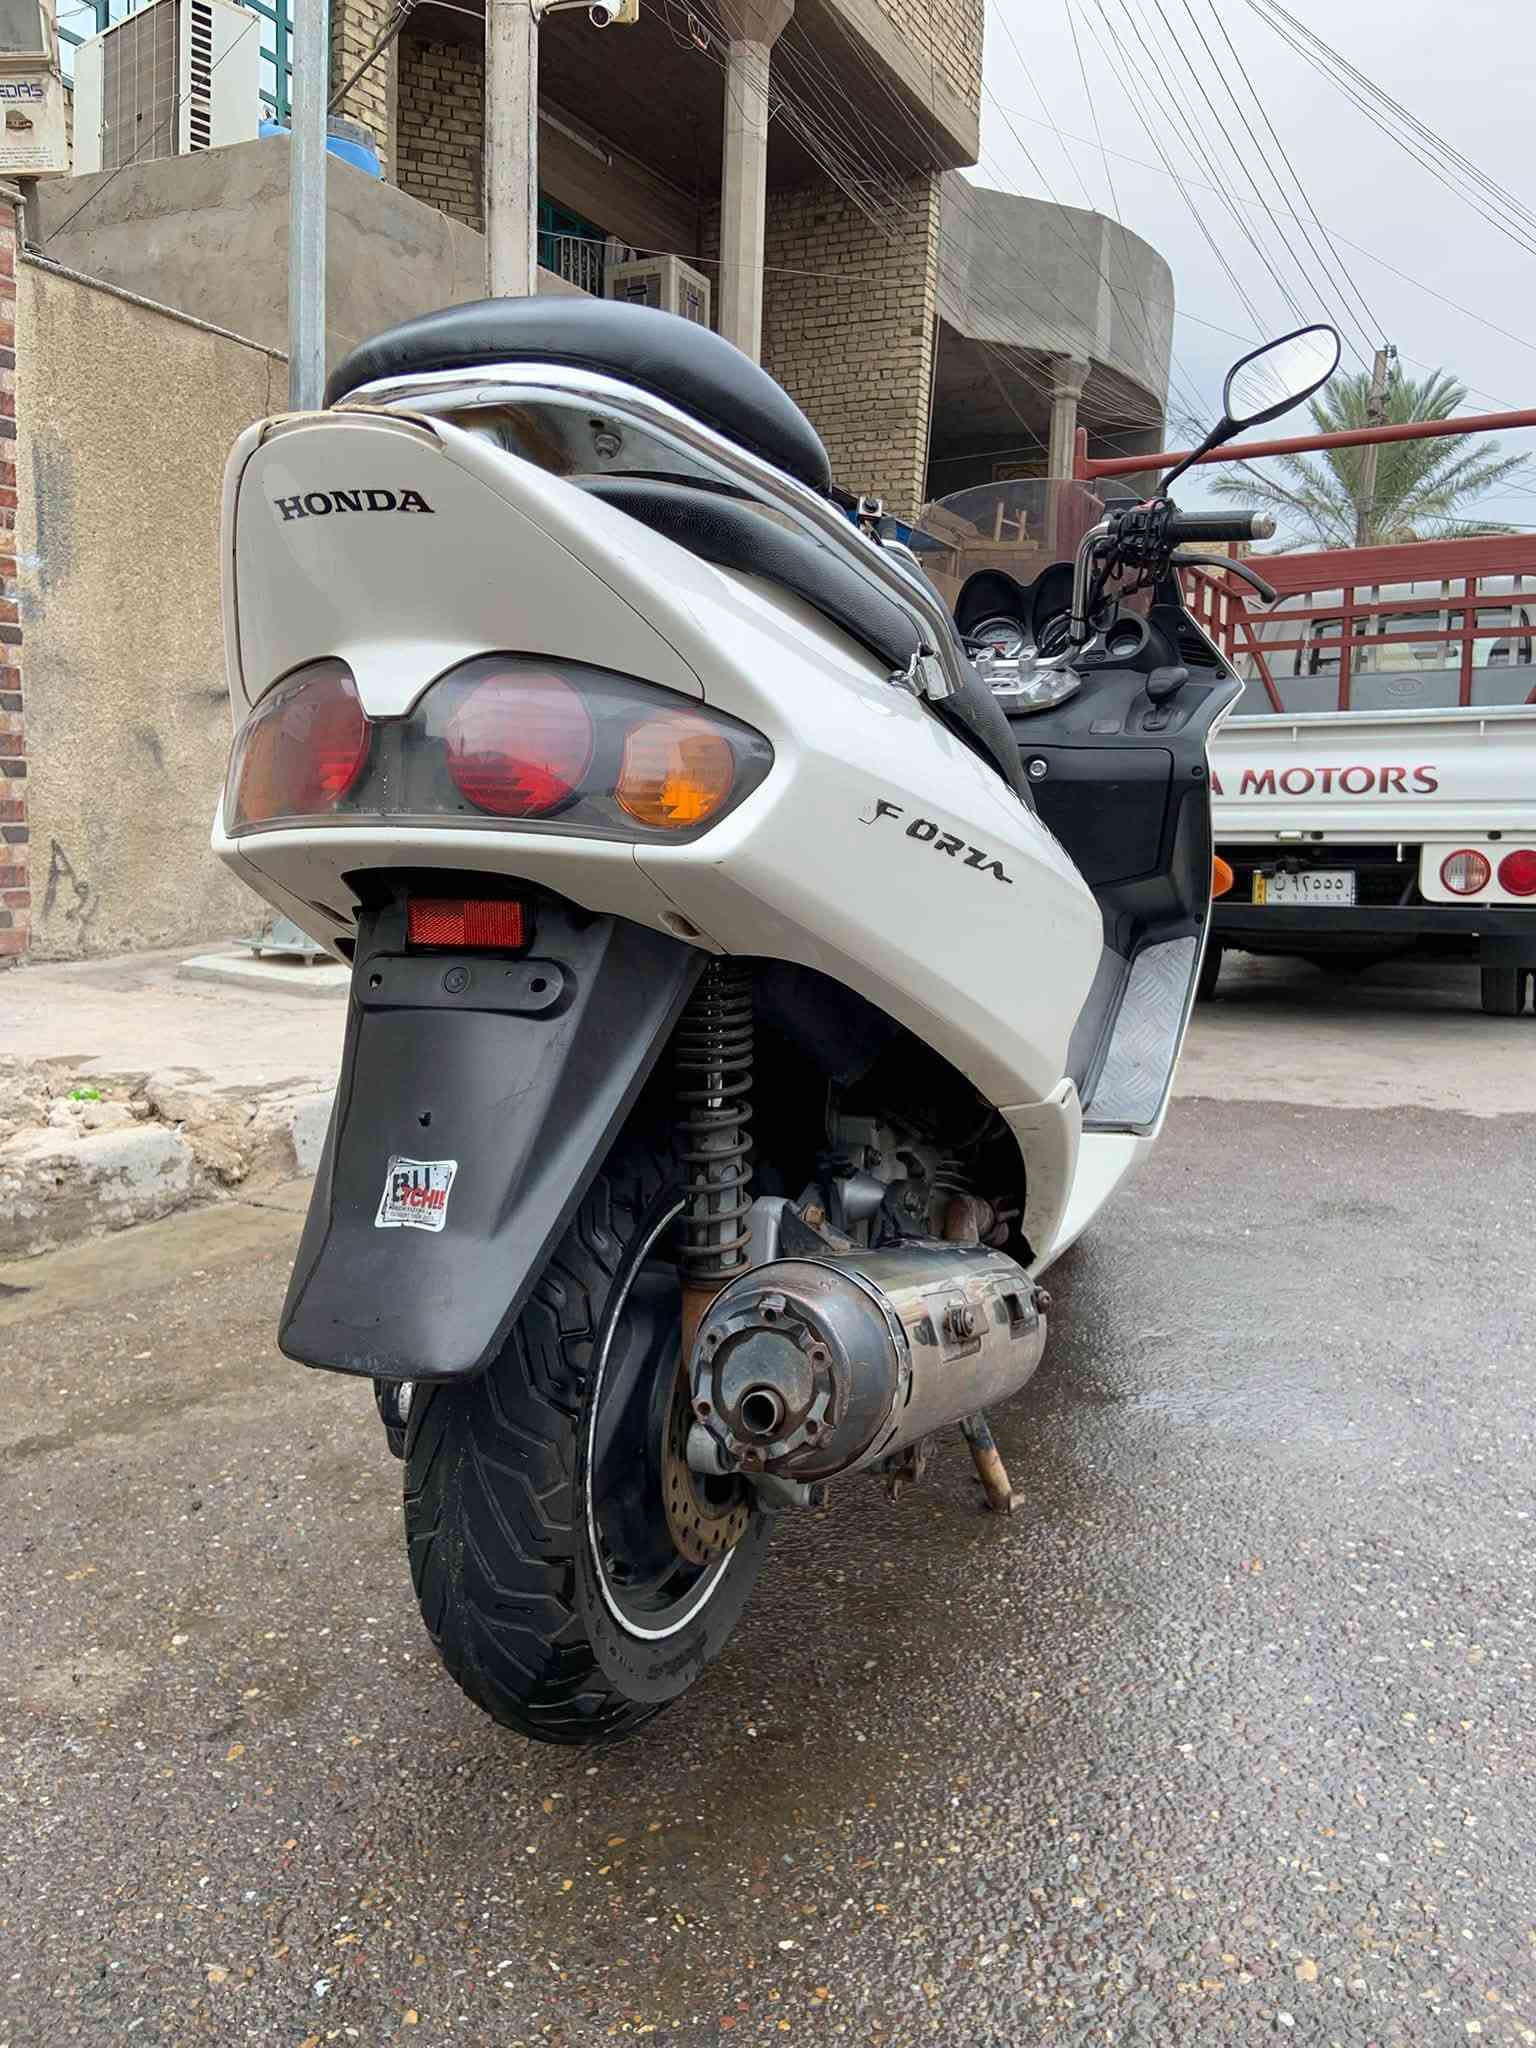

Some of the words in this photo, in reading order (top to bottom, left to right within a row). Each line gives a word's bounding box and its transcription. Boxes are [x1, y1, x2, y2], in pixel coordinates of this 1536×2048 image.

[274, 489, 436, 521] HONDA
[1239, 765, 1439, 796] MOTORS
[857, 799, 1013, 884] FORZA
